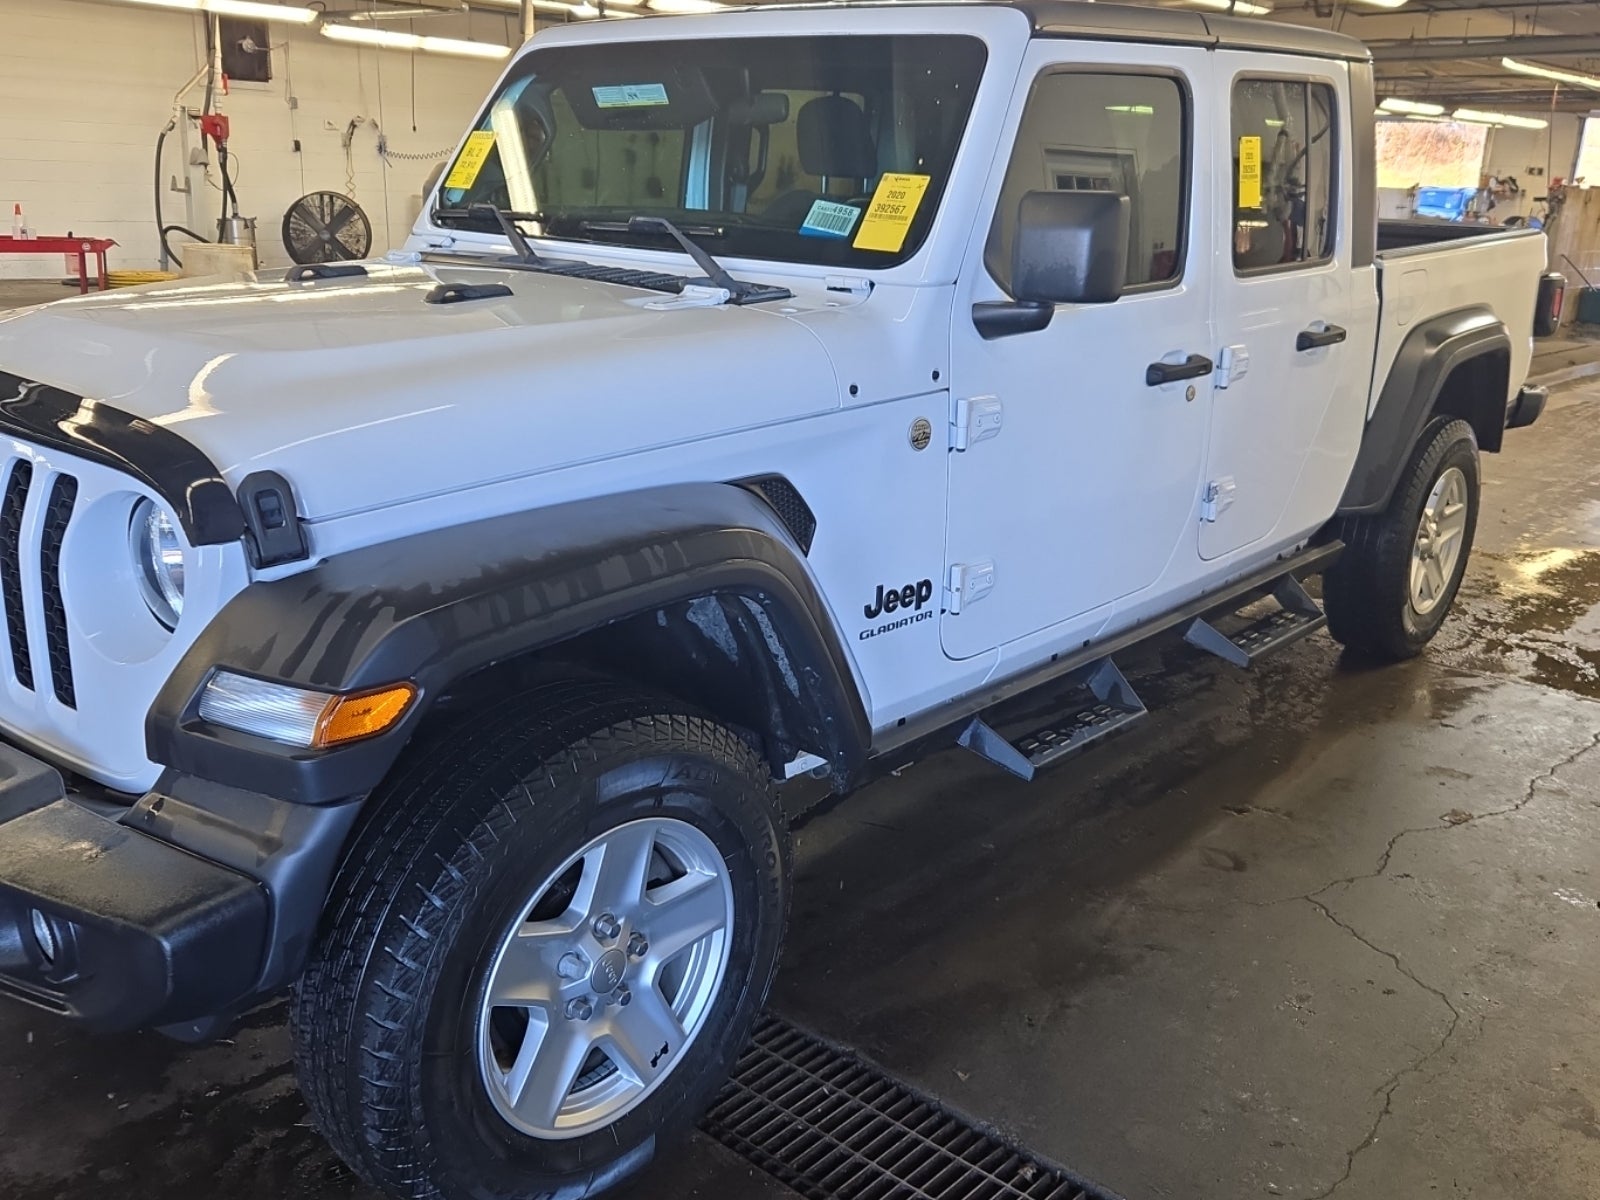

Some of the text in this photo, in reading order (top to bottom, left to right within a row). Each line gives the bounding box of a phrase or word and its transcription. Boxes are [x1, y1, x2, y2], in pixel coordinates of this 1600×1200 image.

[887, 190, 906, 199] 2020
[874, 203, 906, 215] 392567
[863, 578, 933, 620] Jeep
[859, 610, 933, 641] GLADIATOR
